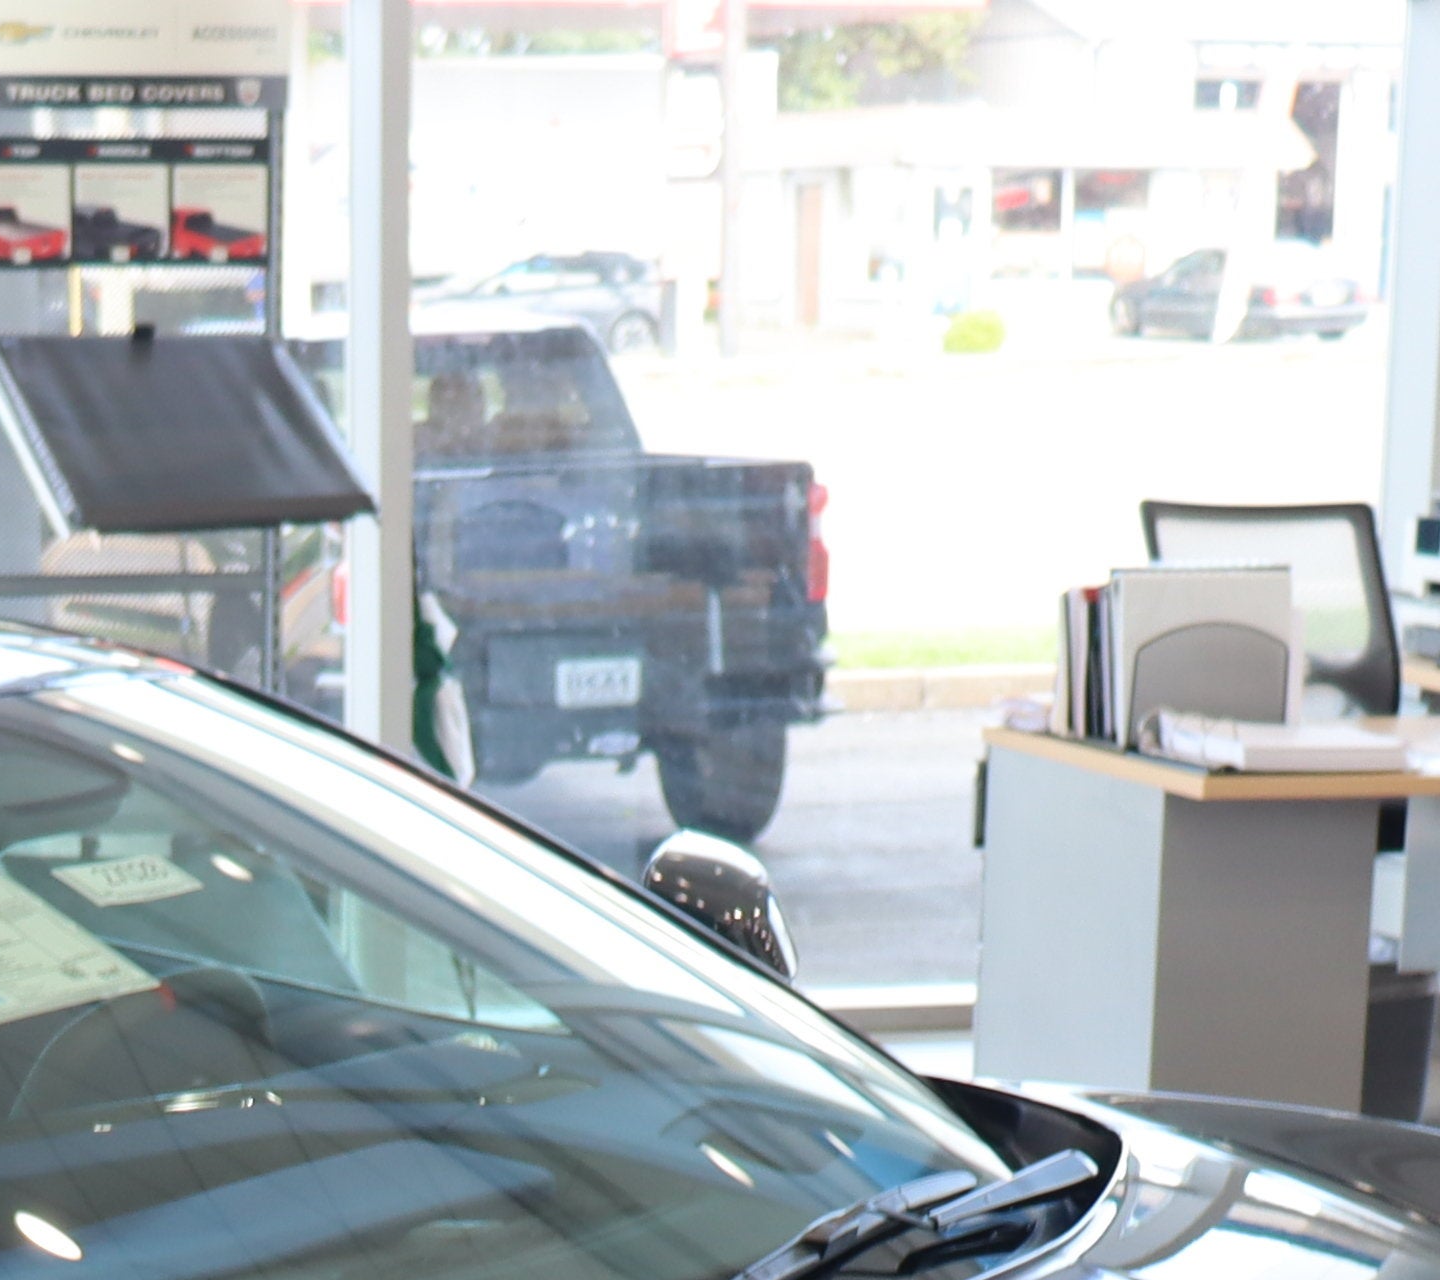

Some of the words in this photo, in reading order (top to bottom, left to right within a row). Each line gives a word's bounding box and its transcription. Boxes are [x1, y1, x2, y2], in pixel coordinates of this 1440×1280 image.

[6, 83, 80, 104] TRUCK
[86, 83, 135, 103] BED
[141, 83, 226, 103] COVERS
